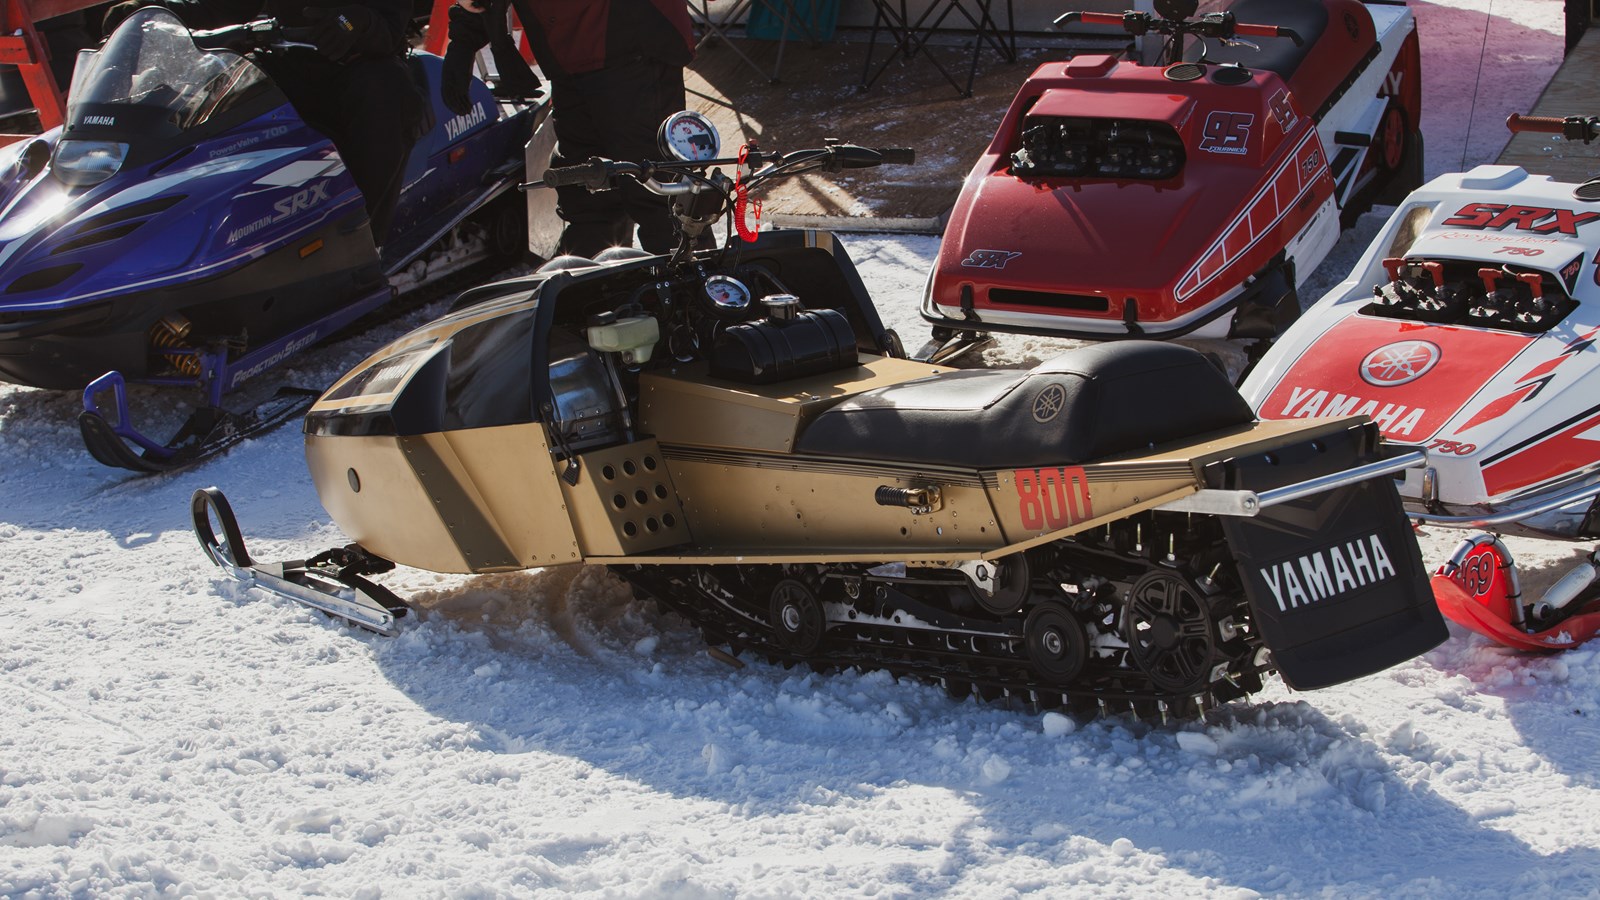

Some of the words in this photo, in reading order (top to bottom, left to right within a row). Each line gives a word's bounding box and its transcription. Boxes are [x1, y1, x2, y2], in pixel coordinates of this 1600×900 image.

[83, 115, 115, 126] YAMAHA
[262, 125, 289, 140] 700
[443, 101, 487, 141] YAMAHA
[1200, 110, 1255, 149] 95
[1302, 149, 1319, 180] 750
[272, 178, 332, 223] SRX
[1441, 202, 1600, 237] SRX
[1493, 245, 1545, 257] 750
[1562, 261, 1580, 281] 750
[1426, 438, 1477, 456] 750
[1014, 465, 1094, 531] 800
[1259, 534, 1396, 612] YAMAHA
